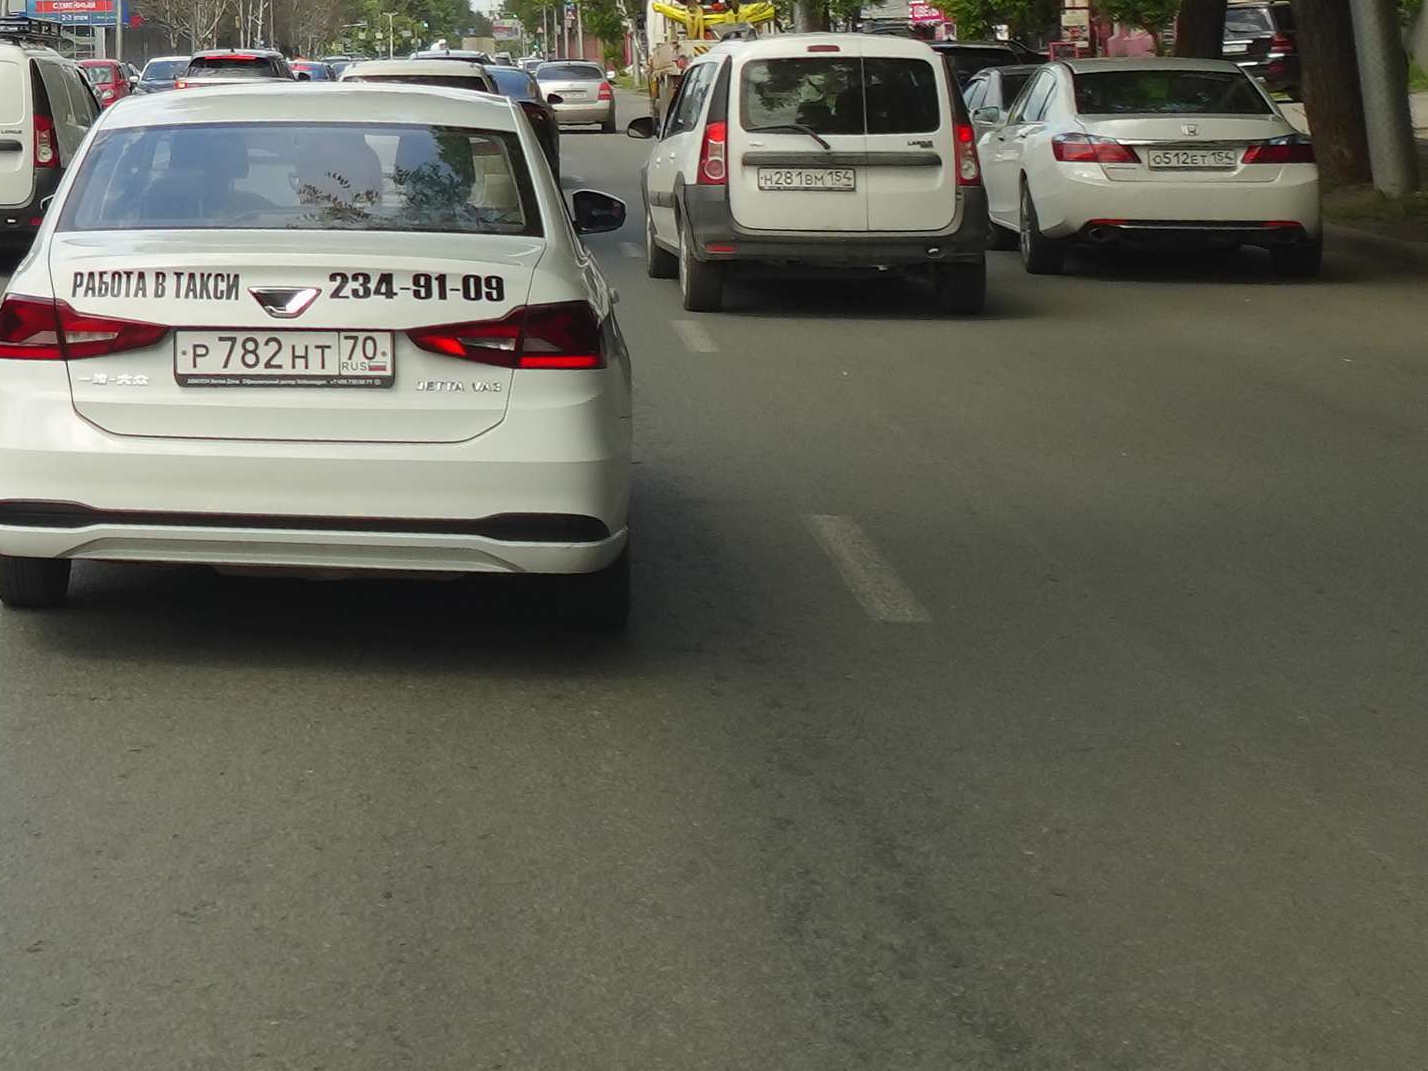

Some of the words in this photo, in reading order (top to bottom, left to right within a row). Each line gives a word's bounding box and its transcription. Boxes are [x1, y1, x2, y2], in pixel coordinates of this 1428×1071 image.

[72, 271, 148, 298] РАБОТА
[153, 272, 166, 299] В
[174, 272, 241, 300] ТАКСИ
[328, 272, 506, 301] 234-91-09
[343, 336, 378, 360] 70
[342, 361, 367, 371] RUS
[416, 381, 465, 392] JETTA
[472, 381, 501, 392] VA3
